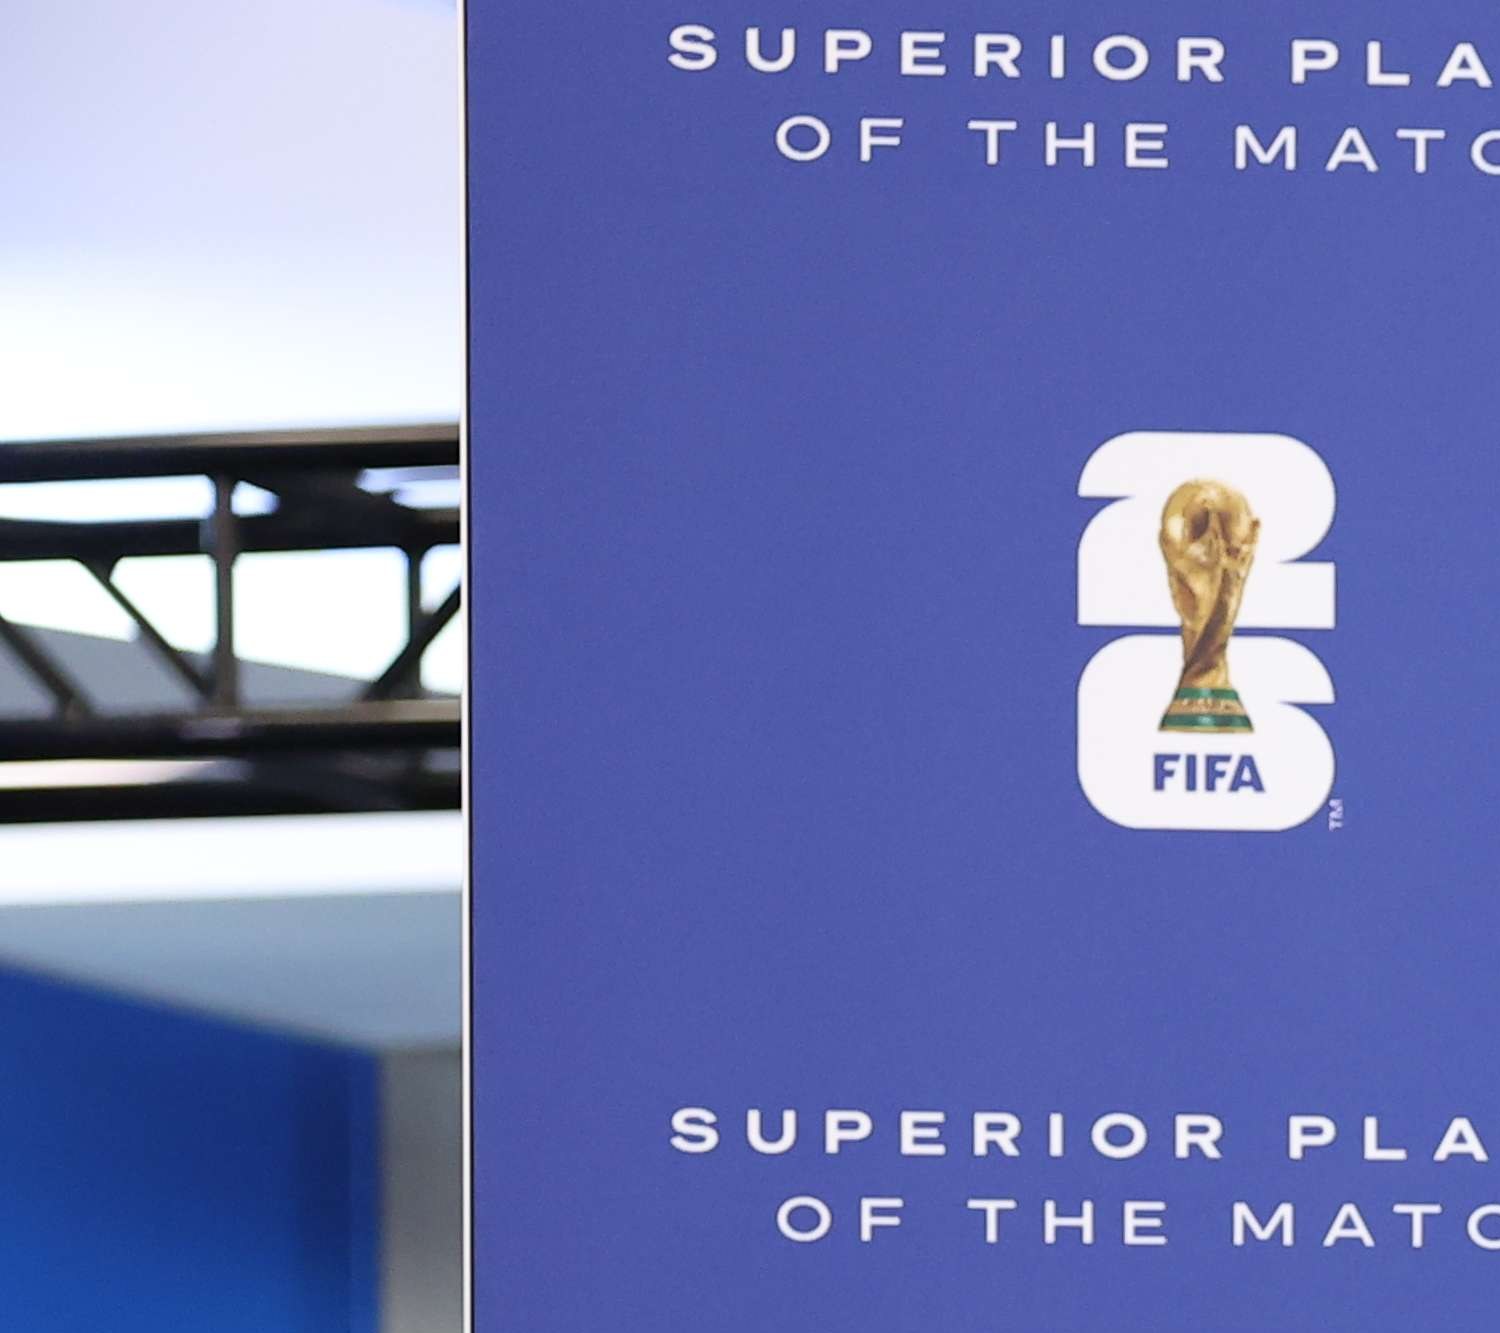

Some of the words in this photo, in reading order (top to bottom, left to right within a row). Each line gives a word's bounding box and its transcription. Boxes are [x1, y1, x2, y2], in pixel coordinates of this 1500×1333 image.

[667, 24, 1225, 82] SUPERIOR
[775, 115, 904, 162] OF
[967, 120, 1169, 169] THE
[1154, 753, 1264, 792] FIFA
[670, 1107, 1223, 1159] SUPERIOR
[776, 1196, 904, 1242] OF
[967, 1198, 1168, 1246] THE
